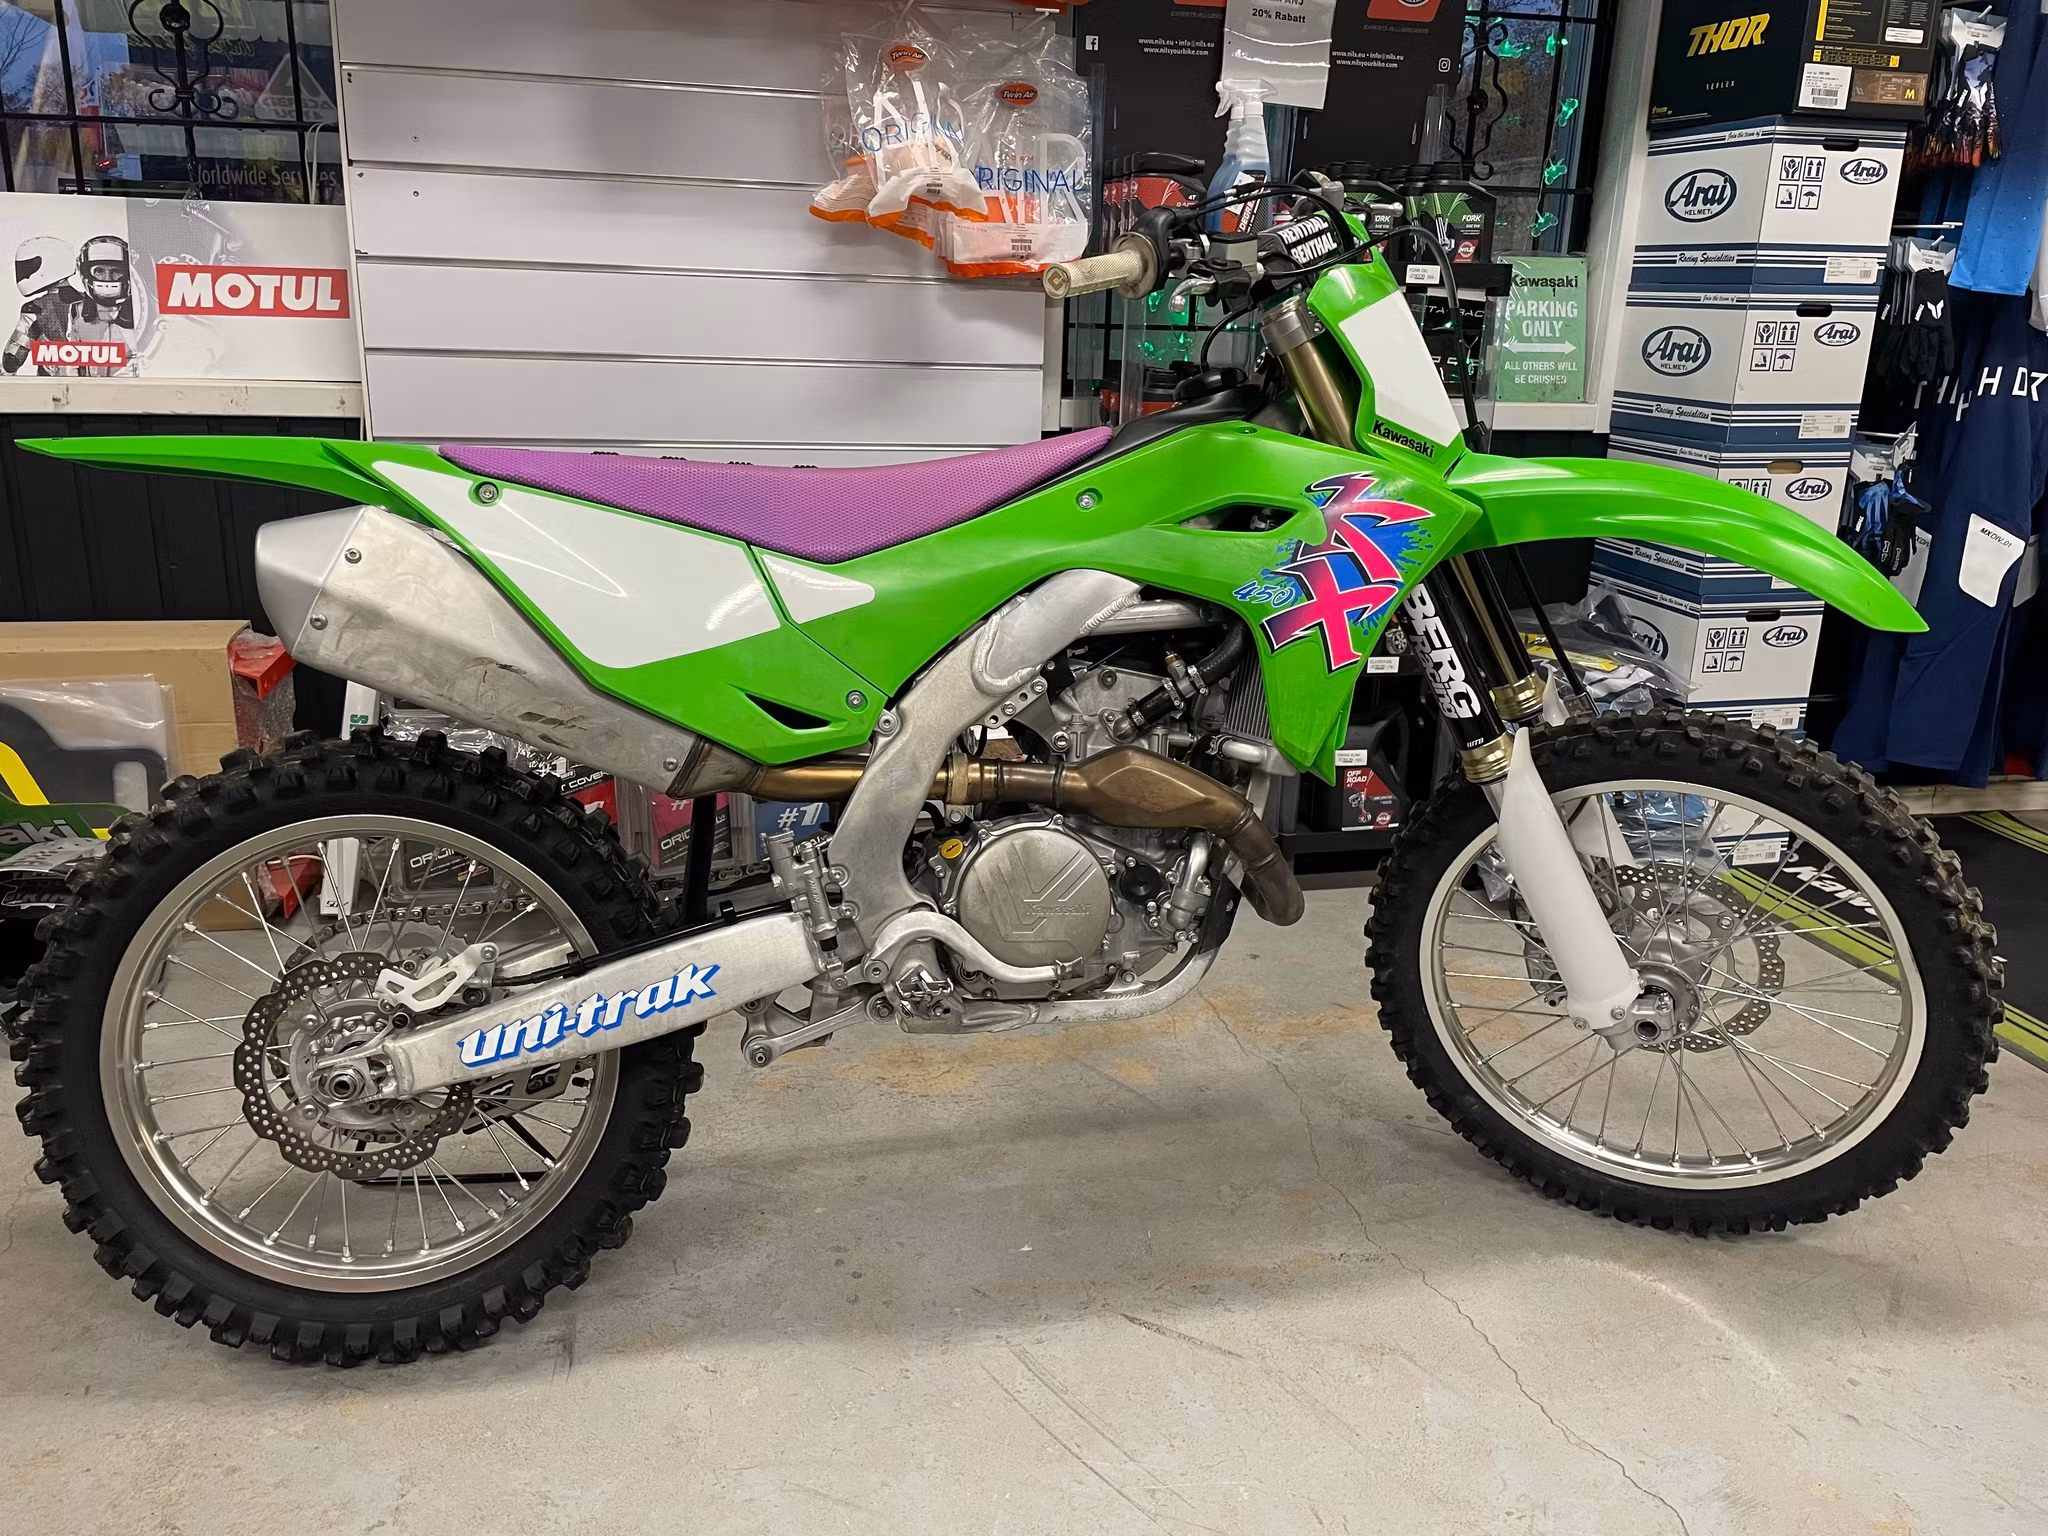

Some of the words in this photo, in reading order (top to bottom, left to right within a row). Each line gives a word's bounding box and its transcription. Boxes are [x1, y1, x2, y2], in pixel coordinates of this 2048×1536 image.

[1252, 8, 1272, 19] 20%
[1275, 11, 1306, 24] Rabatt
[1686, 13, 1770, 58] THOR
[891, 50, 911, 61] Twin
[912, 50, 924, 60] Air
[1003, 89, 1019, 101] Twin
[1020, 88, 1036, 99] Air
[1842, 161, 1882, 178] Arai
[1668, 175, 1730, 207] Arai
[1685, 208, 1713, 216] HELMET
[1277, 215, 1330, 245] RENTHAL
[1290, 231, 1338, 265] RENTHAL
[1679, 253, 1699, 265] Racing
[1700, 252, 1736, 264] Specialities
[1510, 275, 1578, 288] Kawasaki
[168, 271, 342, 311] MOTUL
[1506, 300, 1578, 318] PARKING
[1522, 320, 1563, 337] ONLY
[1816, 324, 1855, 340] Arai
[37, 344, 123, 364] MOTUL
[1646, 331, 1703, 362] Arai
[1504, 361, 1521, 370] ALL
[1522, 361, 1555, 371] OTHERS
[1557, 361, 1578, 371] WILL
[1660, 363, 1687, 371] HELMET
[1514, 374, 1526, 384] BE
[1528, 374, 1567, 385] CRUSHED
[1654, 403, 1674, 418] Racing
[1372, 419, 1435, 459] Kawasaki
[1788, 480, 1827, 495] Arai
[1634, 547, 1652, 562] Racing
[1232, 581, 1297, 608] 450
[1765, 627, 1804, 642] Arai
[1403, 583, 1482, 719] BERG
[1346, 775, 1367, 783] ROAD
[777, 802, 824, 828] #1
[456, 963, 721, 1068] uni-trak
